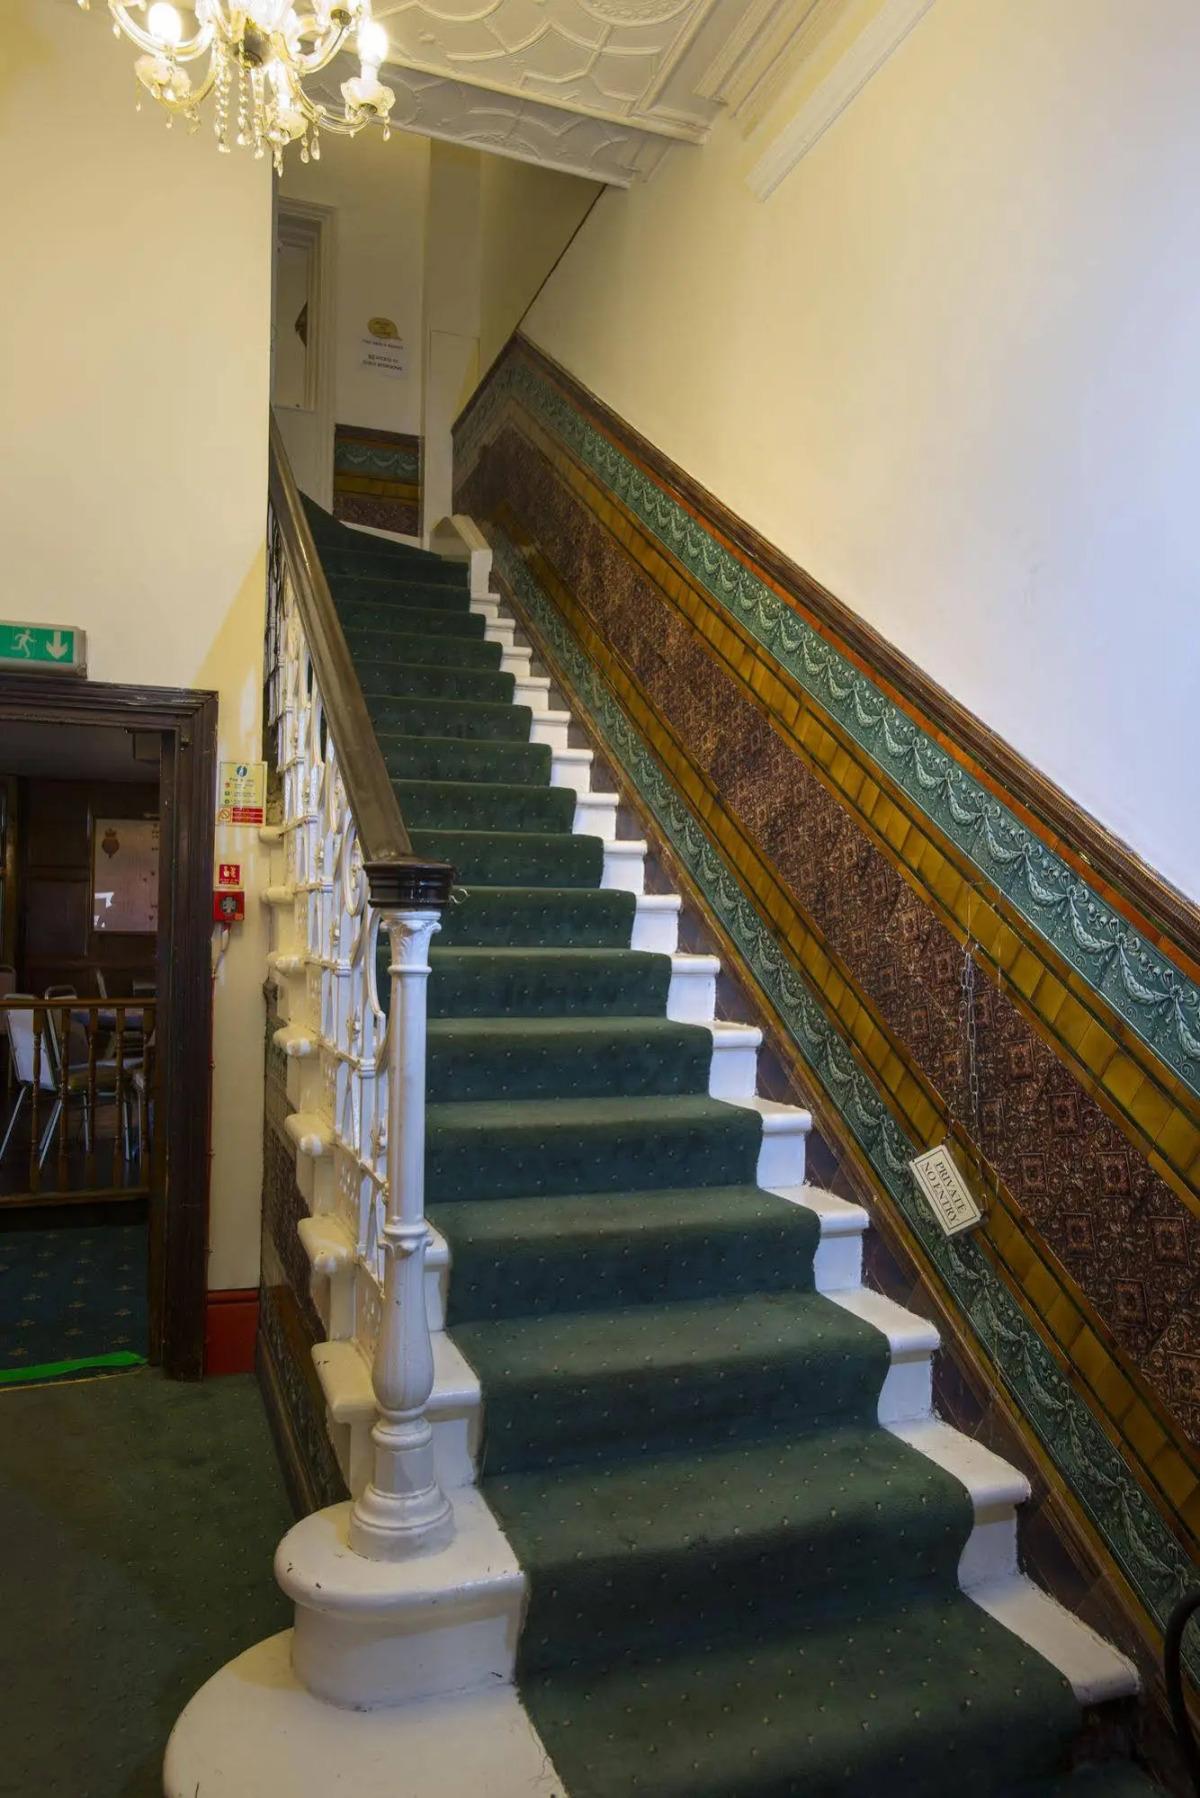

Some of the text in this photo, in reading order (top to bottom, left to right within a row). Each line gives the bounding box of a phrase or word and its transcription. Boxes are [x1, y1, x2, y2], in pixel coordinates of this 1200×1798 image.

[921, 1161, 960, 1222] NO ENTRY
[935, 1161, 967, 1214] PRIVATE
